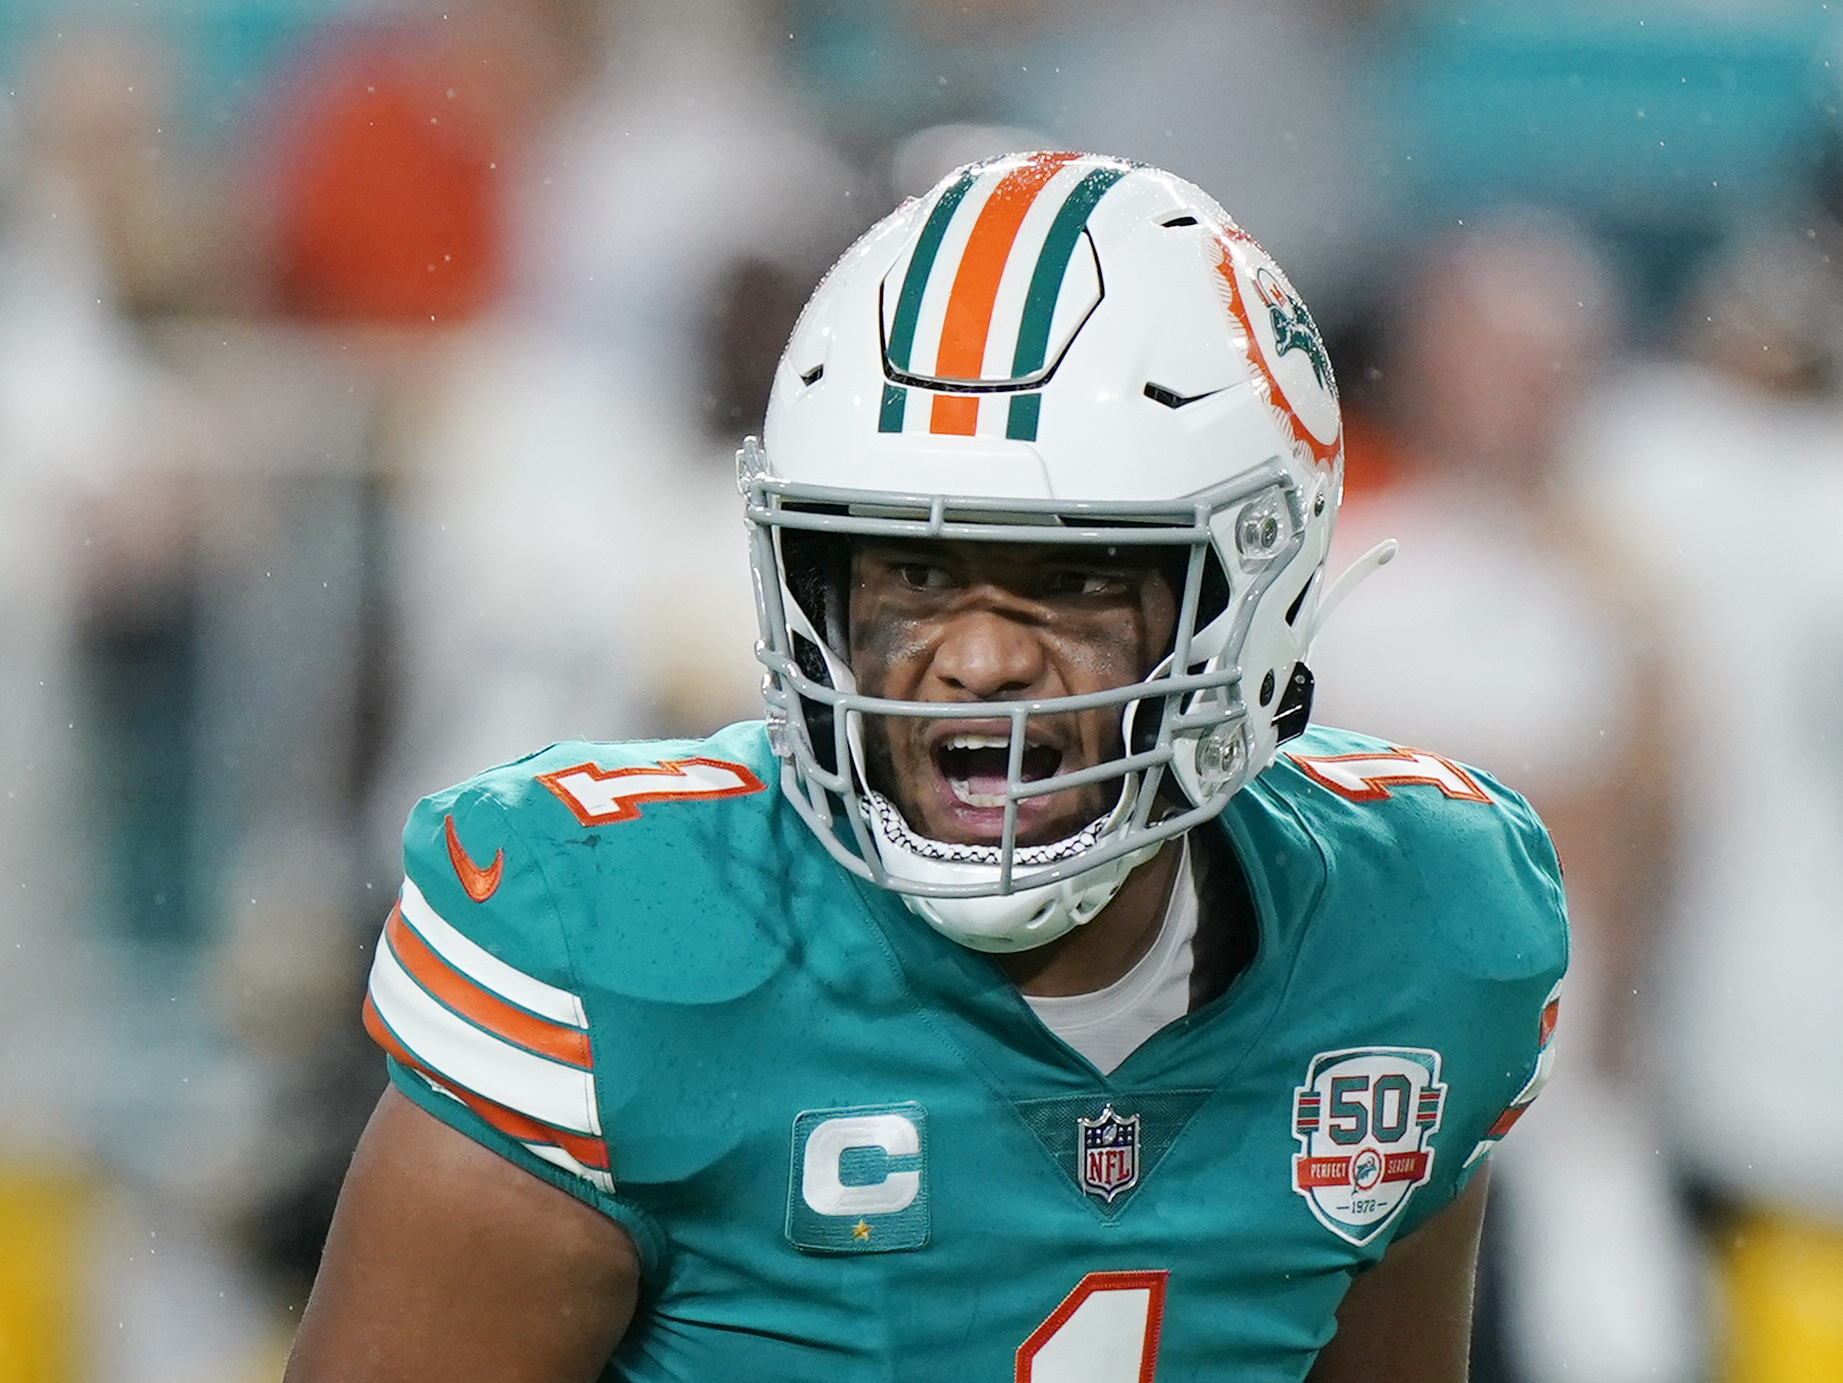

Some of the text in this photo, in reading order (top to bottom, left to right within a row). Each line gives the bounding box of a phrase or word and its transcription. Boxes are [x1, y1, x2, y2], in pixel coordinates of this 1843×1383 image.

[534, 757, 767, 827] 1
[1284, 746, 1494, 803] 1
[1329, 1074, 1411, 1145] 50
[802, 1114, 922, 1216] C
[1089, 1150, 1130, 1185] NFL
[1310, 1157, 1415, 1179] PERFECT SEASON
[1351, 1199, 1376, 1214] 1972
